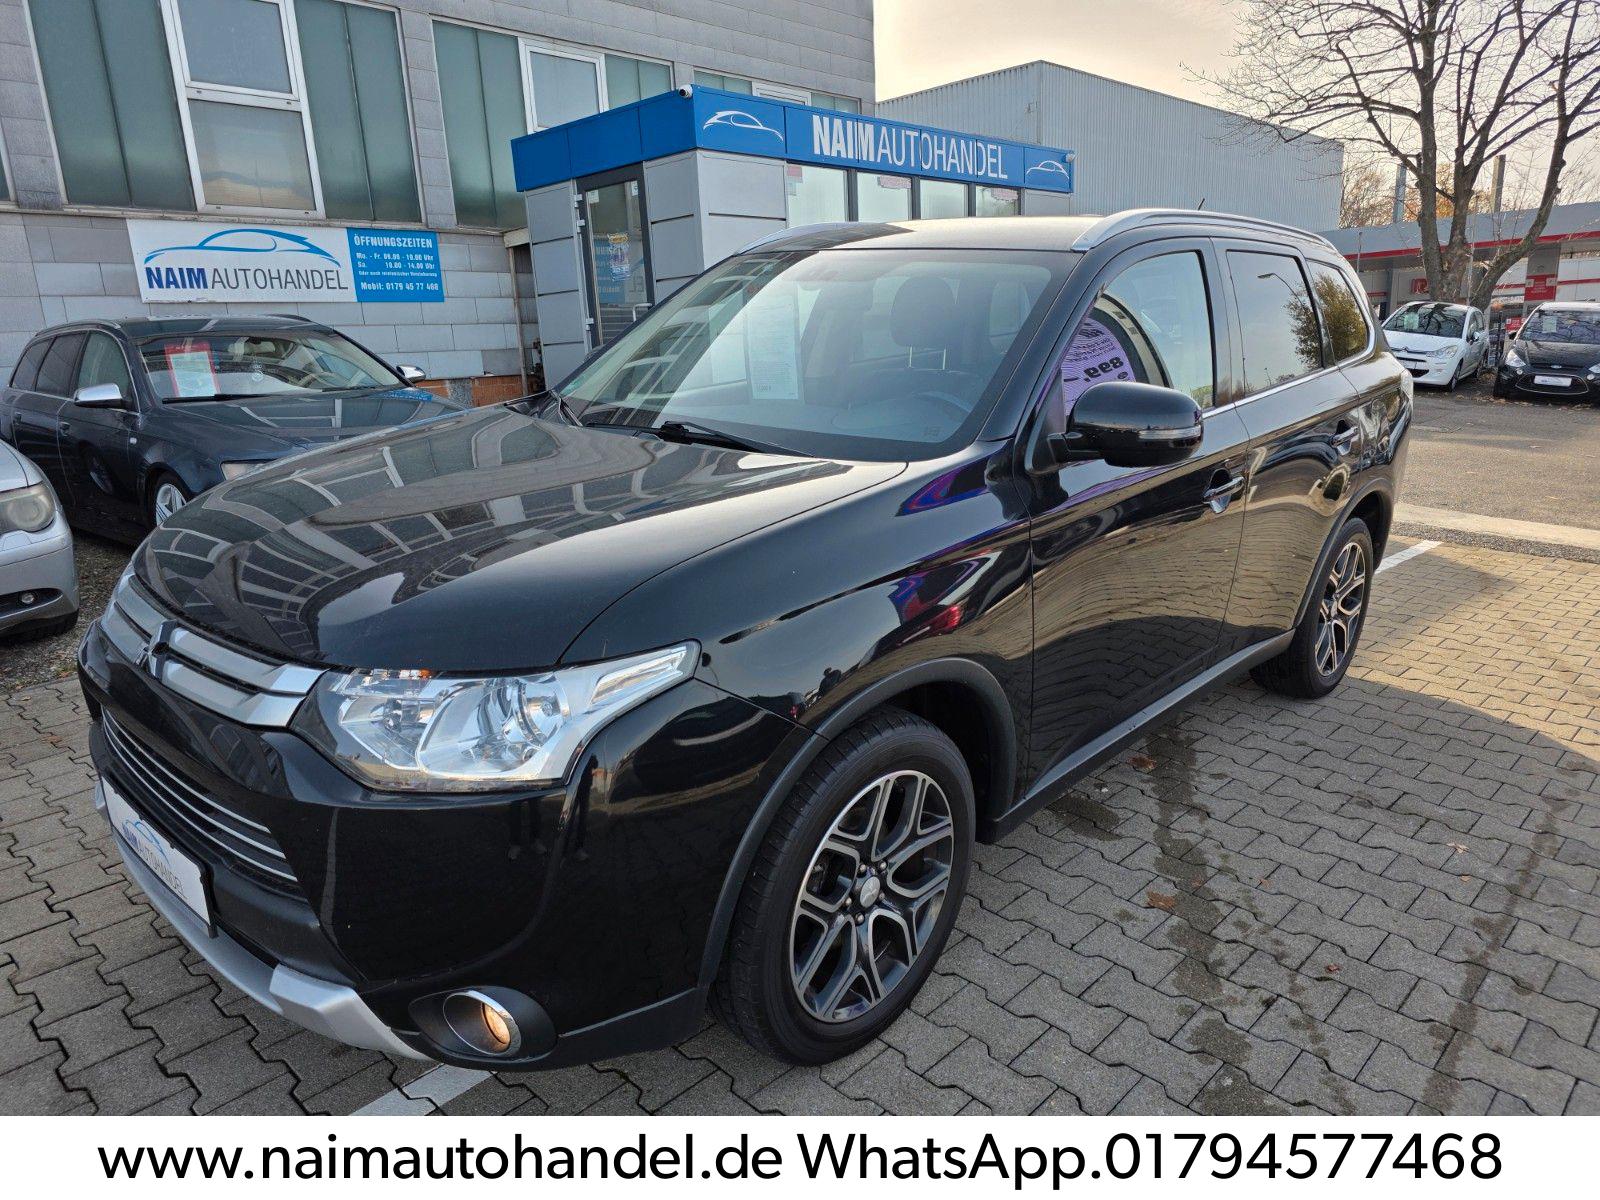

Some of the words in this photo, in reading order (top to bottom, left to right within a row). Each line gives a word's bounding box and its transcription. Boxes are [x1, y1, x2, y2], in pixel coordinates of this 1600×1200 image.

[812, 114, 875, 162] NAIM
[877, 126, 1008, 179] AUTOHANDEL
[353, 233, 433, 248] ÖFFNUNGSZEITEN
[145, 267, 208, 289] NAIM
[211, 268, 349, 290] AUTOHANDEL
[360, 281, 384, 290] Mobil:
[385, 282, 404, 290] 0179
[405, 282, 414, 291] 45
[416, 282, 424, 291] 77
